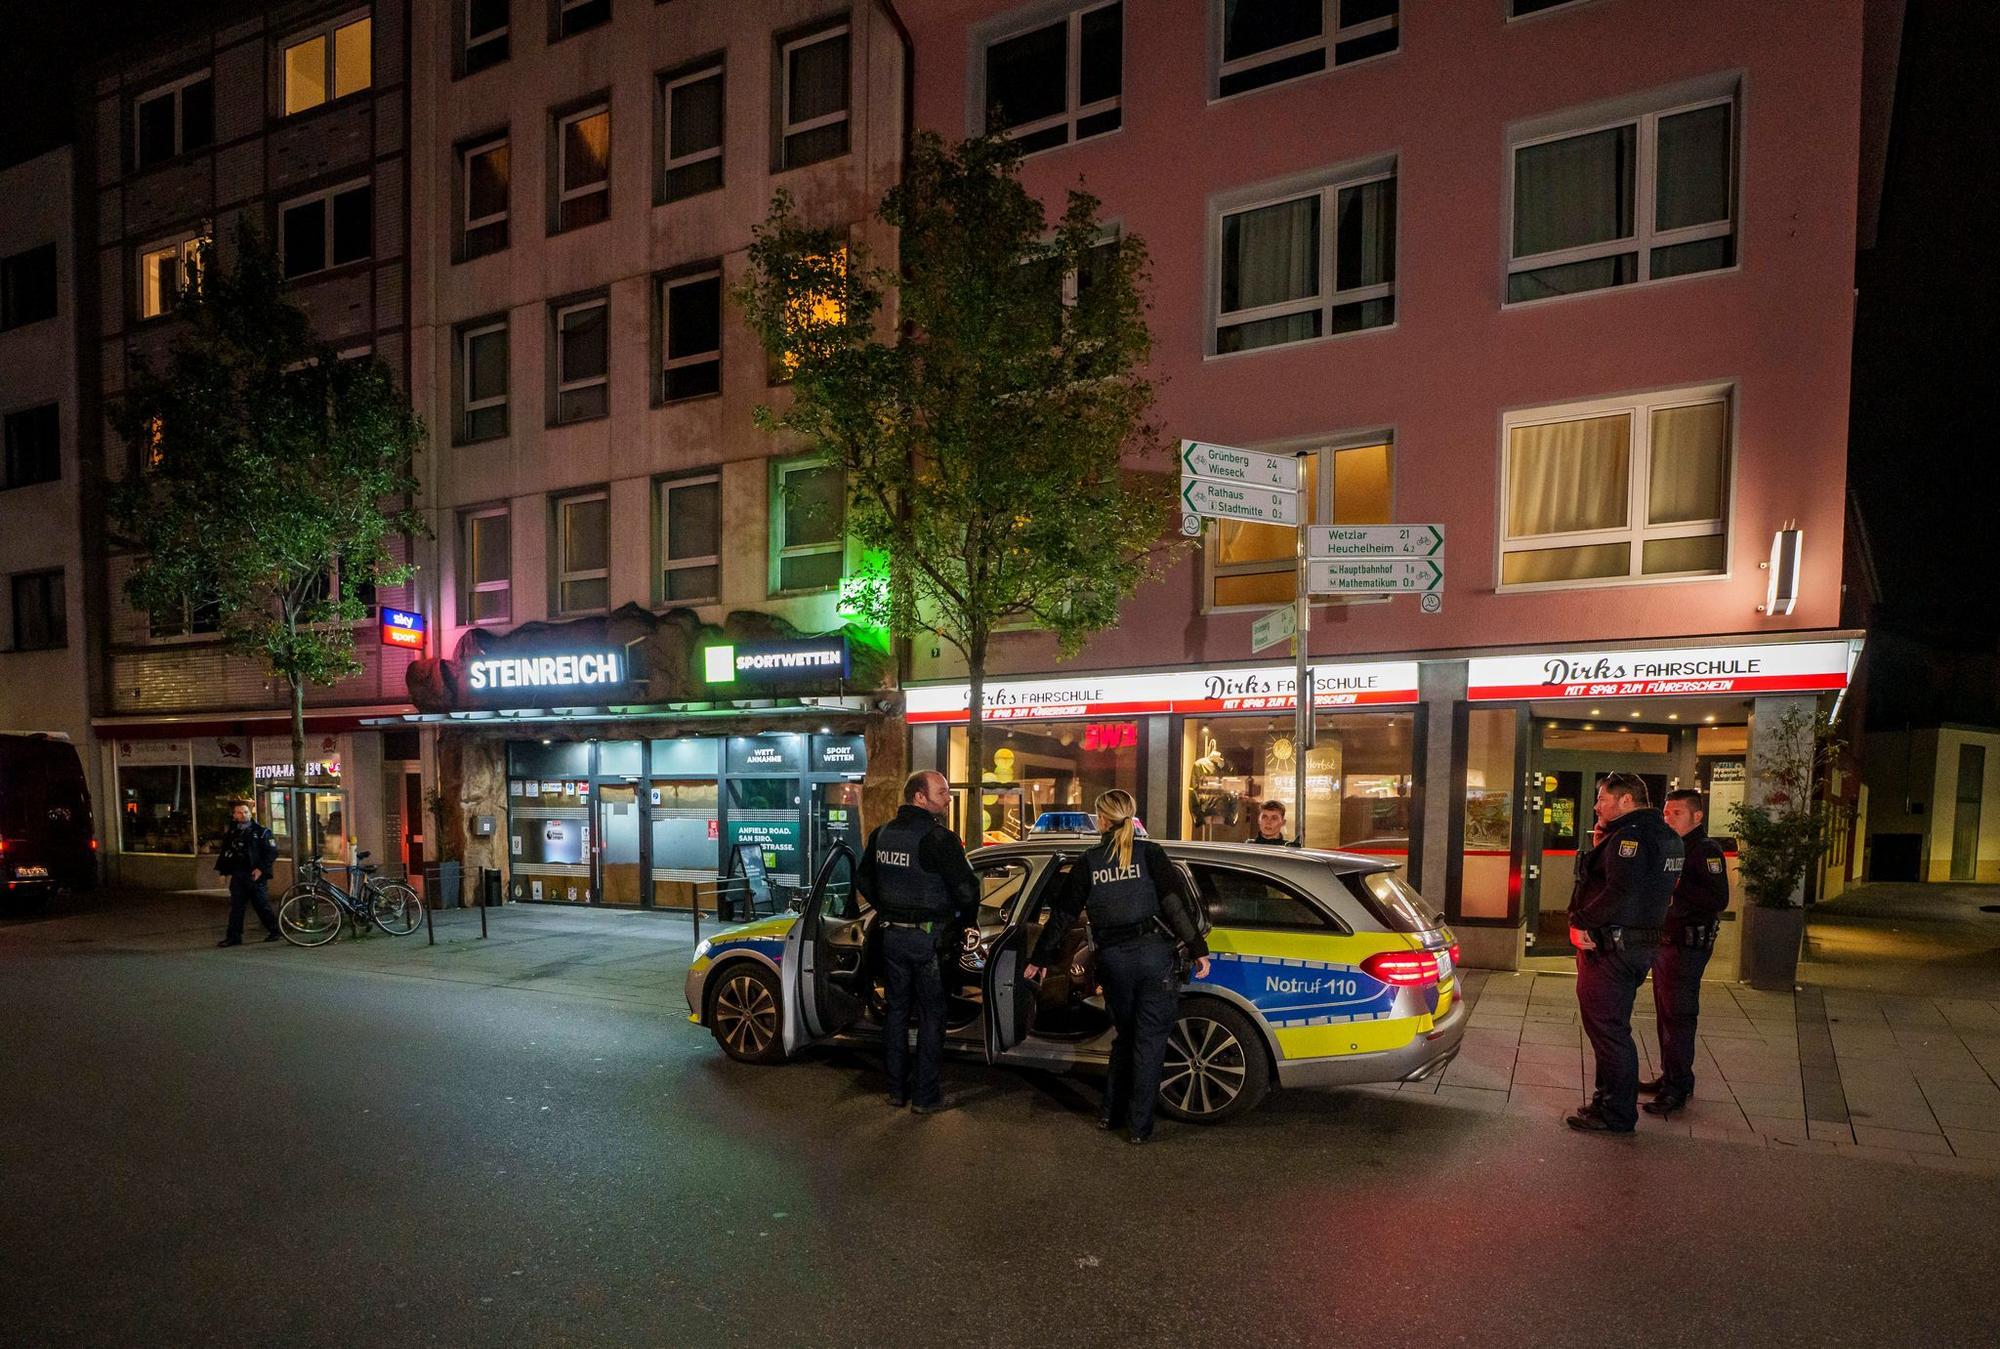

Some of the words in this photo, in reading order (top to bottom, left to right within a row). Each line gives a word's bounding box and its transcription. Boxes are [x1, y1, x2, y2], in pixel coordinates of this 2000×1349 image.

[1208, 449, 1249, 467] Grünberg
[1266, 458, 1277, 469] 24
[1208, 463, 1245, 478] Wieseck
[1207, 485, 1244, 500] Rathaus
[1218, 501, 1263, 517] Stadtmitte
[1328, 530, 1367, 540] Wetzlar
[1399, 529, 1410, 539] 21
[1328, 543, 1394, 553] Heuchelheim
[1338, 564, 1393, 576] Hauptbahnhof
[1338, 577, 1397, 588] Mathematikum
[392, 612, 414, 629] sky
[391, 633, 416, 643] sport
[736, 650, 841, 670] SPORTWETTEN
[469, 654, 618, 689] STEINREICH
[1542, 658, 1628, 686] Dirks
[1634, 659, 1761, 678] FAHRSCHULE
[1204, 674, 1271, 700] Dirks
[1277, 676, 1378, 692] FASCHULE
[1564, 685, 1586, 696] MIT
[1619, 683, 1645, 695] ZUM
[1646, 680, 1735, 693] FÜHRERSCHEIN
[1021, 689, 1104, 704] FAHRSCHULE
[754, 748, 775, 756] WETT
[823, 753, 854, 762] WETTEN
[826, 746, 852, 755] SPORT
[747, 755, 782, 763] ANNAHME
[769, 827, 791, 835] ROAD.
[876, 849, 910, 867] POLIZEI
[1092, 863, 1141, 885] POLIZEI
[1265, 975, 1322, 994] Notruf
[1326, 979, 1357, 996] 110
